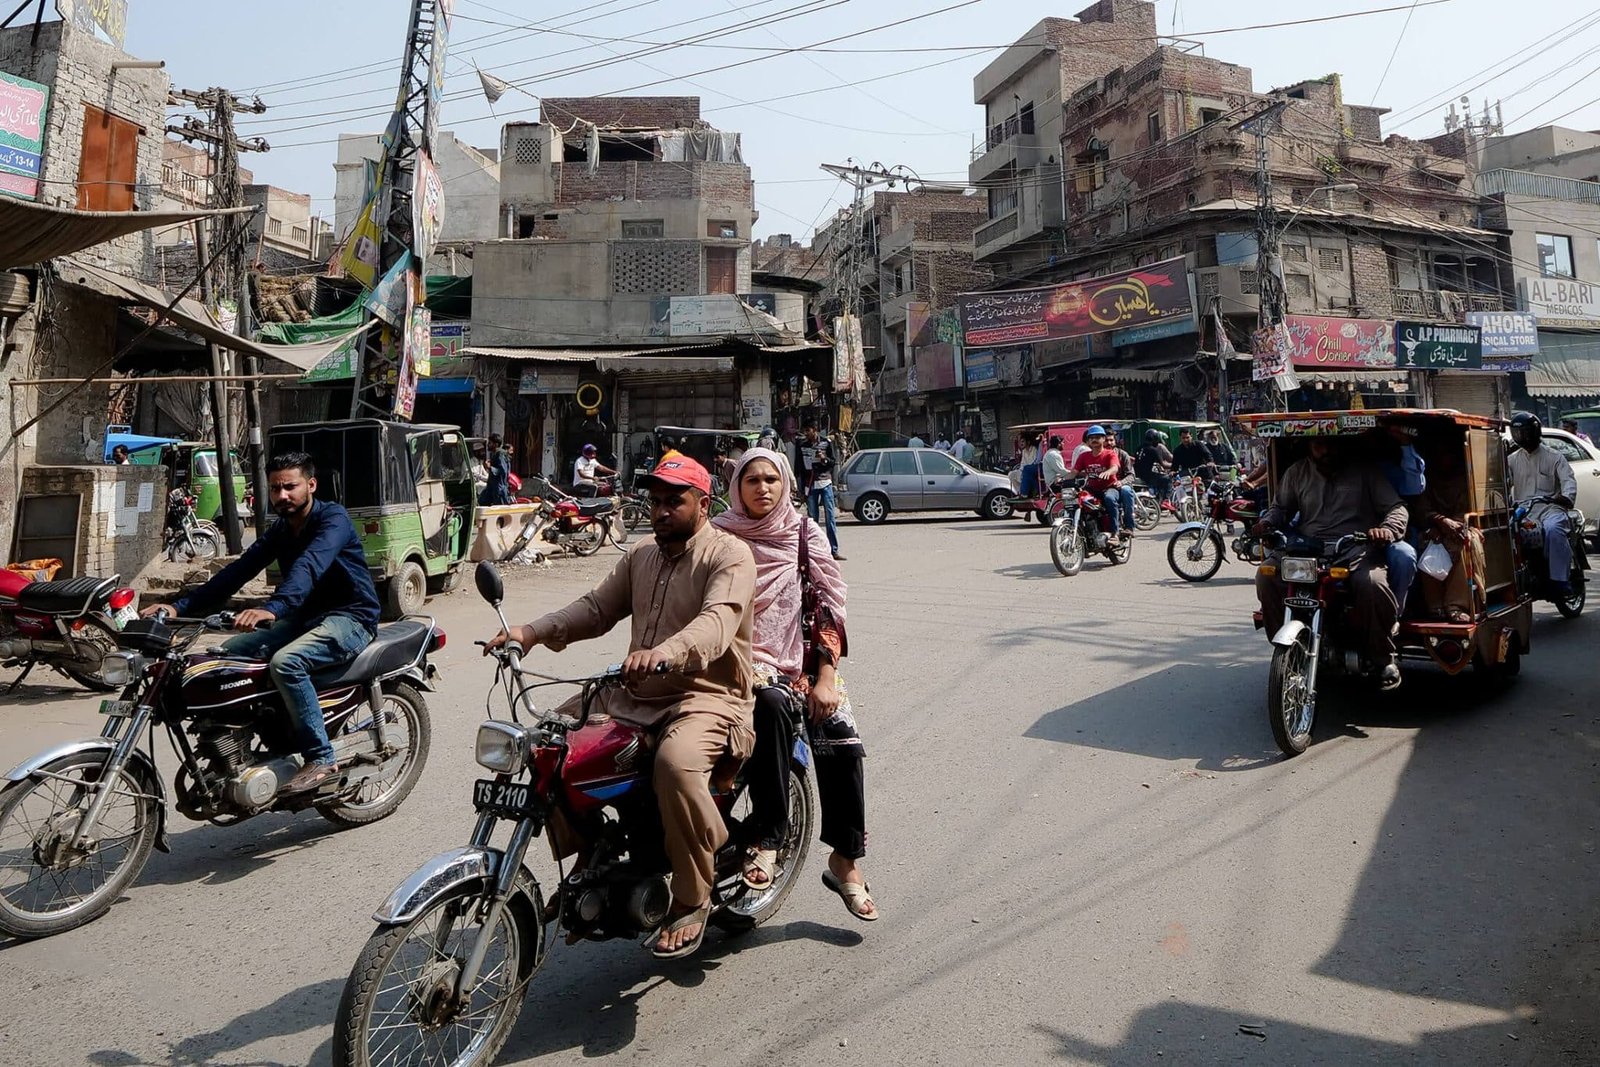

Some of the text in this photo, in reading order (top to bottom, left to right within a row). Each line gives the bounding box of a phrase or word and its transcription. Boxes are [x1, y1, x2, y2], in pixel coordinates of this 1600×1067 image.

[15, 155, 34, 168] 13-14
[1532, 280, 1594, 305] AL-BARI
[1546, 303, 1584, 316] MEDICOS
[1418, 327, 1479, 344] A.P PHARMACY
[1510, 335, 1535, 346] STORE
[220, 678, 253, 690] HONDA
[477, 783, 528, 808] TS 2110
